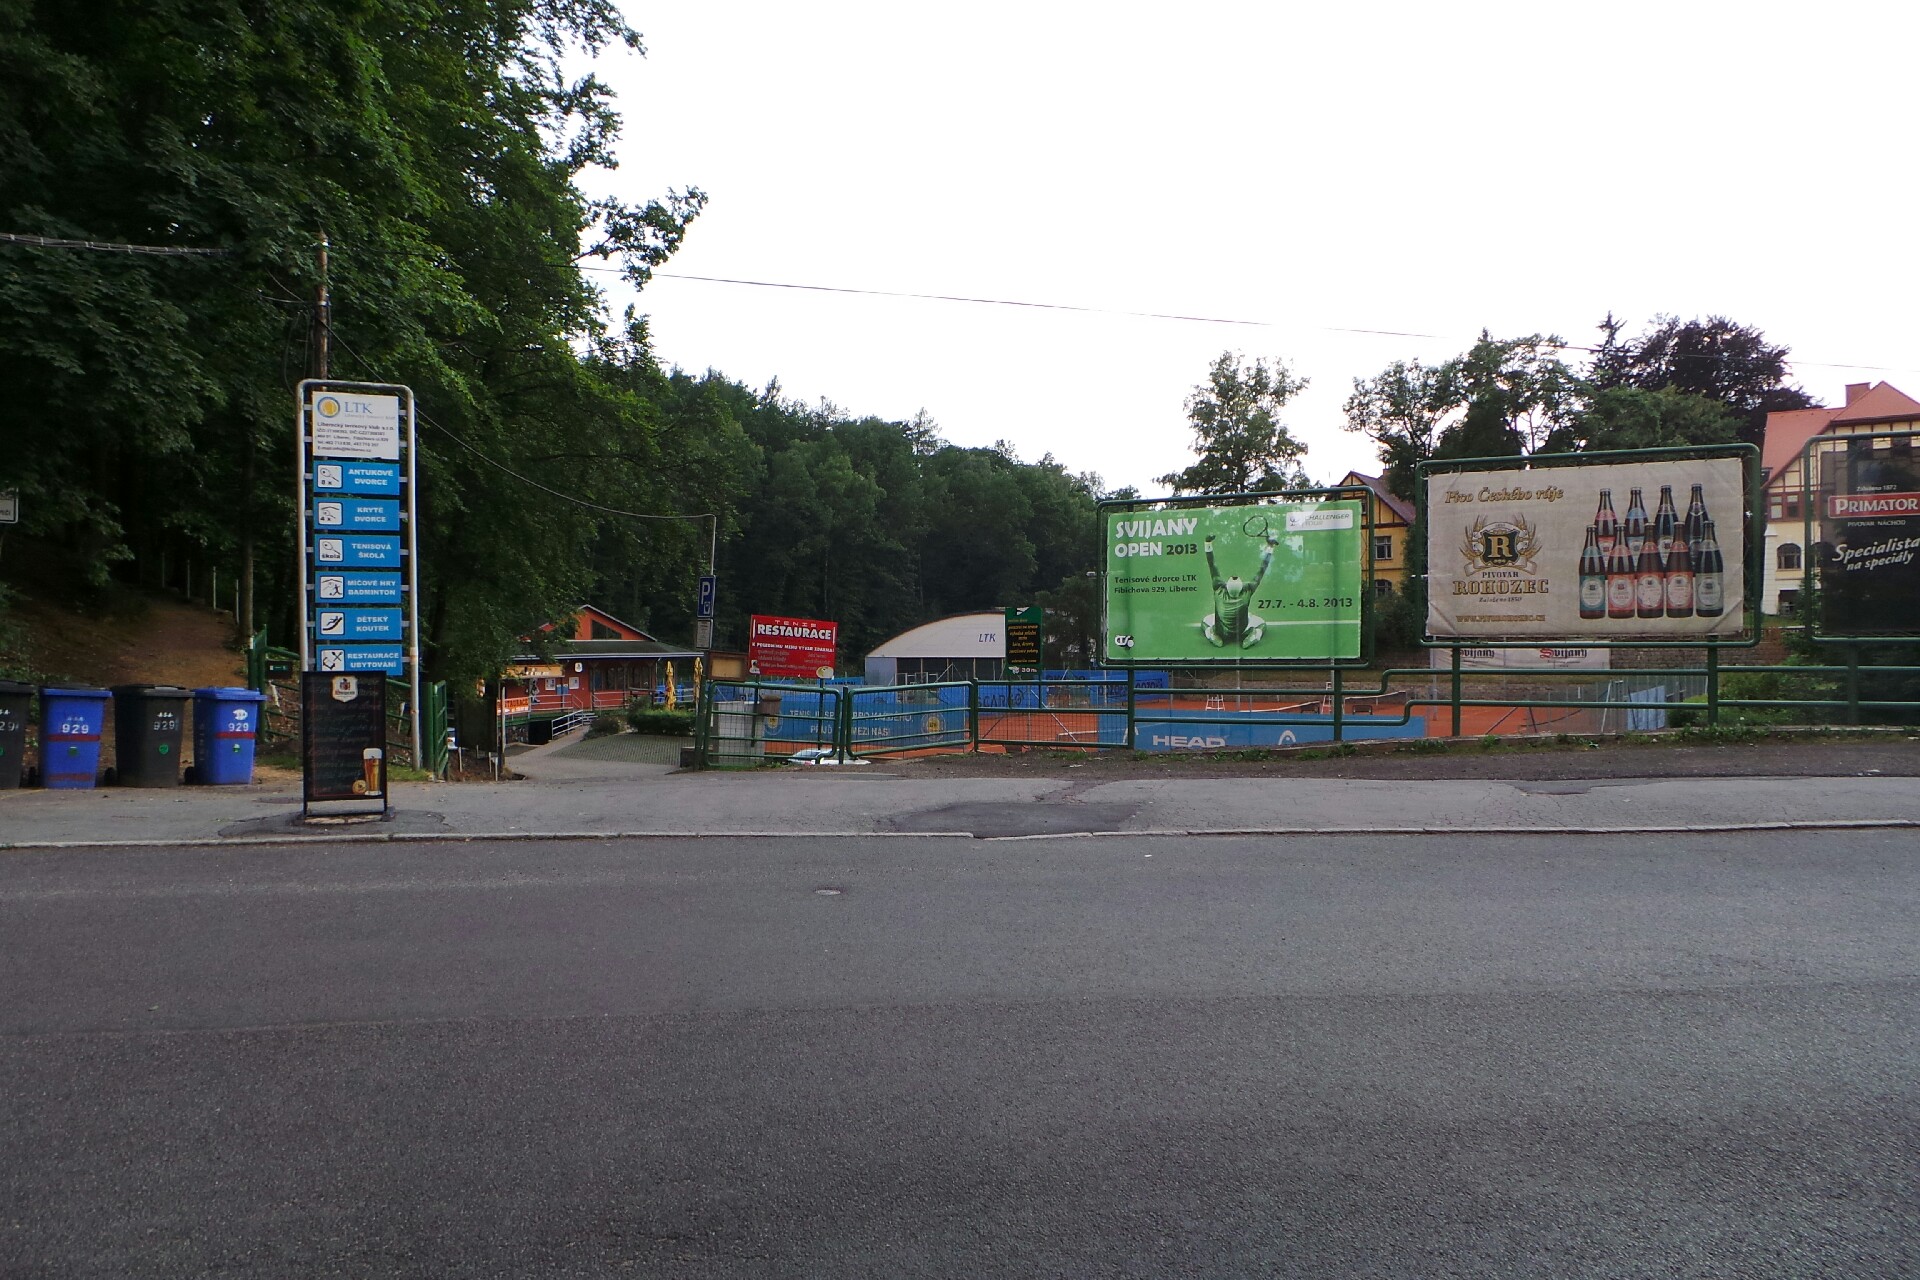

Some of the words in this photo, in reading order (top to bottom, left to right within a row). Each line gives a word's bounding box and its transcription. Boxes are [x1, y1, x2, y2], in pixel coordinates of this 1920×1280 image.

[344, 402, 372, 414] LTK
[1445, 491, 1473, 503] Pivo
[1478, 487, 1532, 502] Českého
[1536, 485, 1564, 502] ráje
[1835, 498, 1918, 514] PRIMATOR
[1116, 518, 1198, 539] SVIJANY
[1114, 542, 1162, 558] OPEN
[1166, 544, 1198, 555] 2013
[1488, 535, 1513, 558] R
[1832, 538, 1920, 564] Specialista
[1846, 562, 1862, 570] na
[1865, 550, 1914, 570] speciály
[701, 582, 710, 604] P
[1452, 579, 1549, 595] ROHOZEC
[1258, 600, 1286, 608] 27.7.
[1297, 599, 1319, 608] 4.8.
[1323, 598, 1352, 607] 2013
[758, 624, 832, 640] RESTAURACE
[775, 620, 816, 628] TENIS
[979, 634, 995, 642] LTK
[1460, 648, 1495, 659] vijany
[1540, 648, 1587, 659] Svijany
[62, 724, 89, 734] 929
[154, 720, 175, 731] 929
[228, 722, 249, 732] 929
[1152, 735, 1226, 748] HEAD
